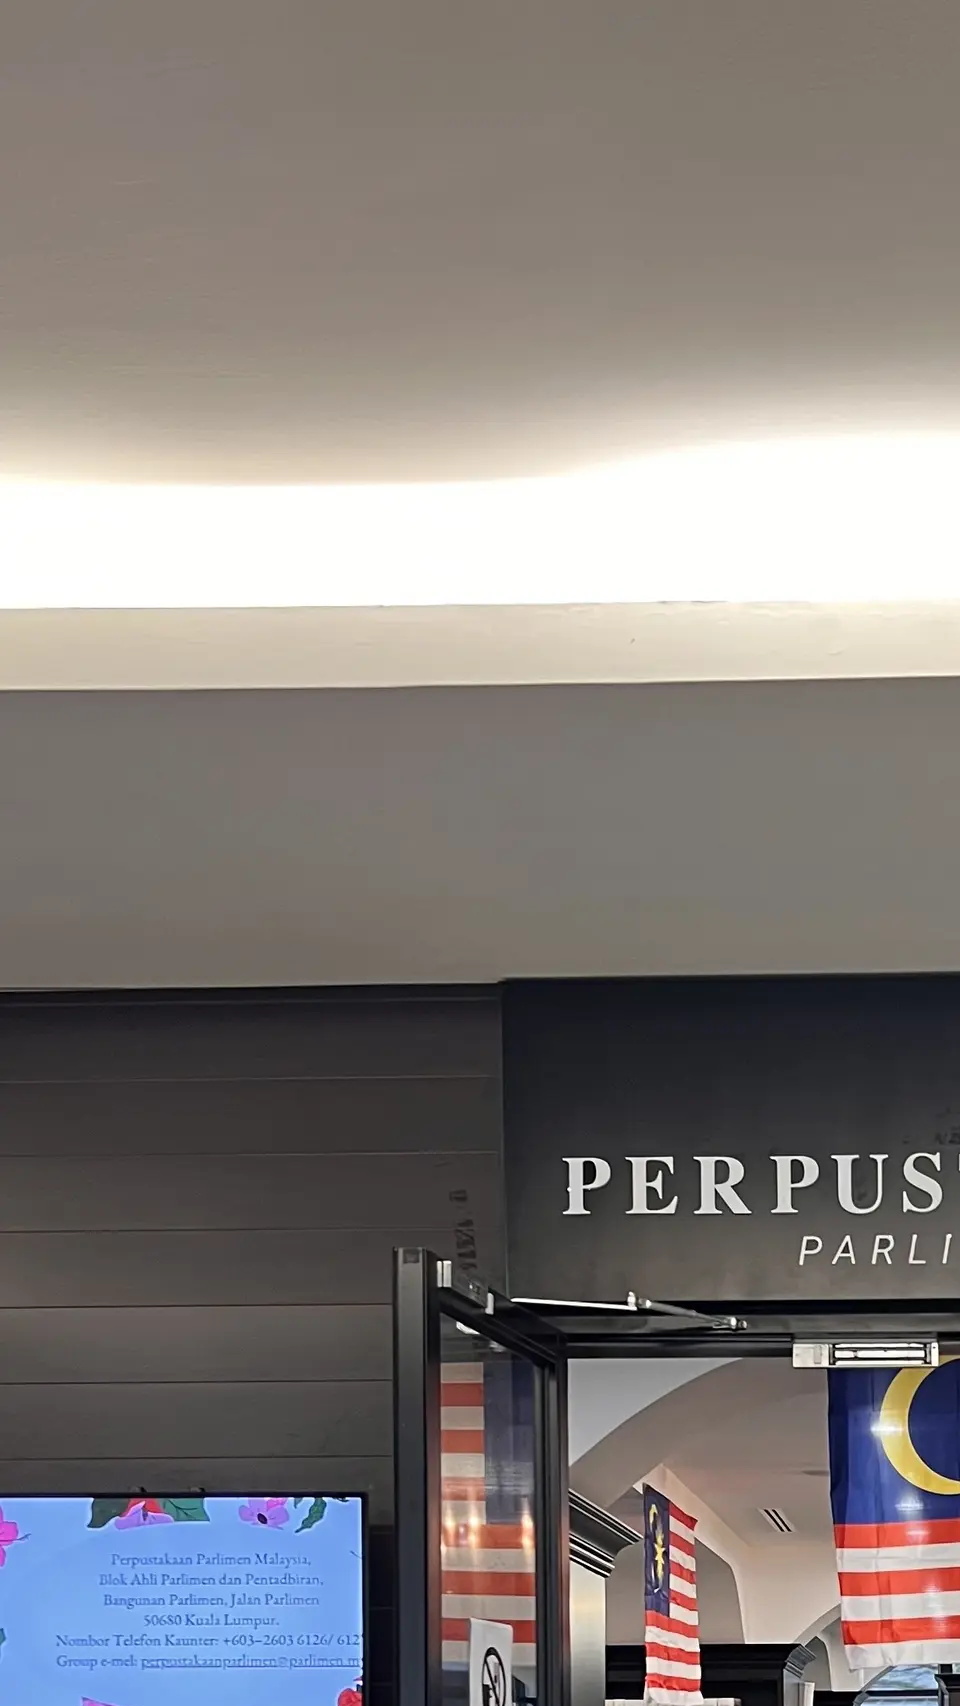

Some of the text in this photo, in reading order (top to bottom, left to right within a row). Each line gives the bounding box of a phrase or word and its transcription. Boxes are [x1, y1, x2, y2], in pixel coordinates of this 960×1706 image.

[111, 1552, 312, 1569] Perpustakaan Parlimen Malaysia,
[99, 1573, 324, 1587] Blok Ahli Parlimen dan Pentadbiran,
[103, 1593, 320, 1610] Bangunan Parlimen, Jalan Parlimen
[143, 1613, 280, 1631] 50680 Kuala Lumpur.
[56, 1634, 111, 1647] Nombor
[112, 1634, 162, 1647] Telefon
[164, 1634, 219, 1647] Kaunter:
[296, 1634, 334, 1647] 6126/
[337, 1633, 363, 1647] 612
[56, 1653, 363, 1671] Group e-mel: perpustakaanparlimen@parlimen.m
